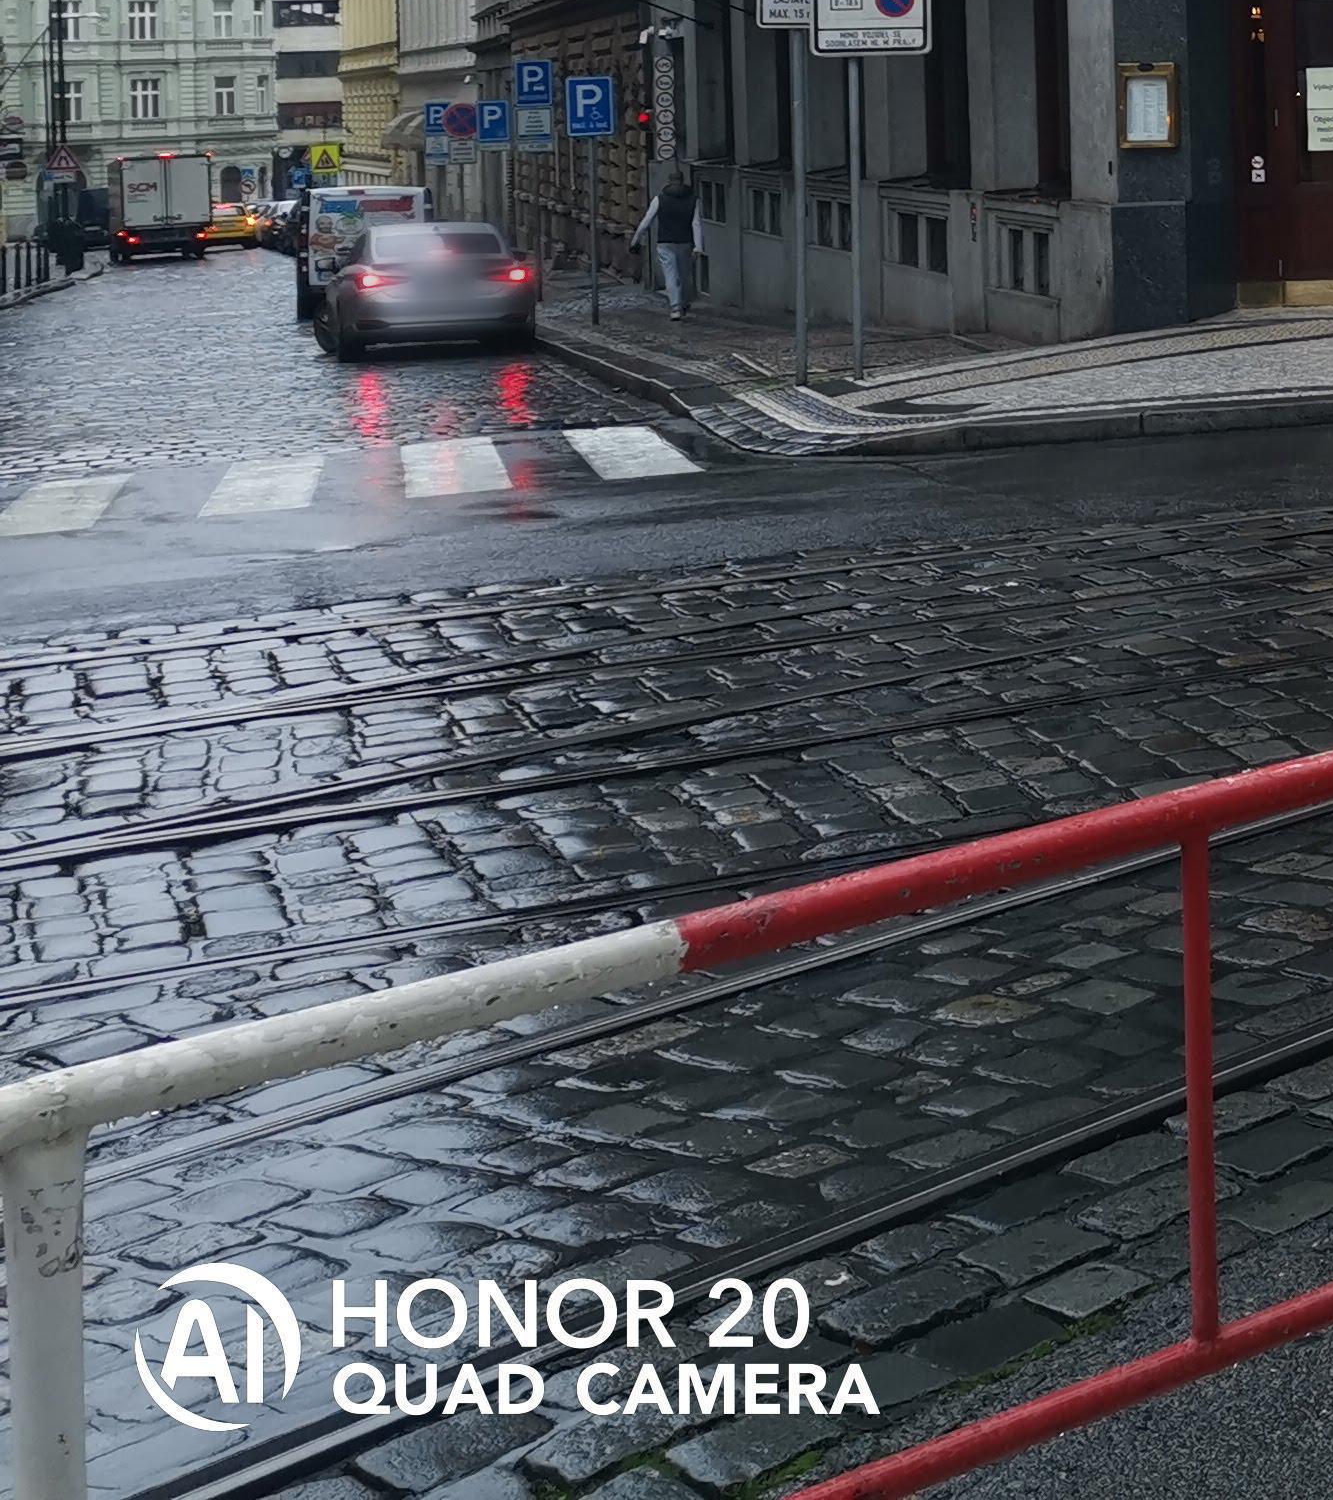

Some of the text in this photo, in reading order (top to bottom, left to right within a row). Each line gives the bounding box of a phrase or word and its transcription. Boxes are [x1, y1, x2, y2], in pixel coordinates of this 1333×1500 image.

[522, 65, 544, 93] P
[575, 84, 603, 118] P
[482, 105, 503, 129] P
